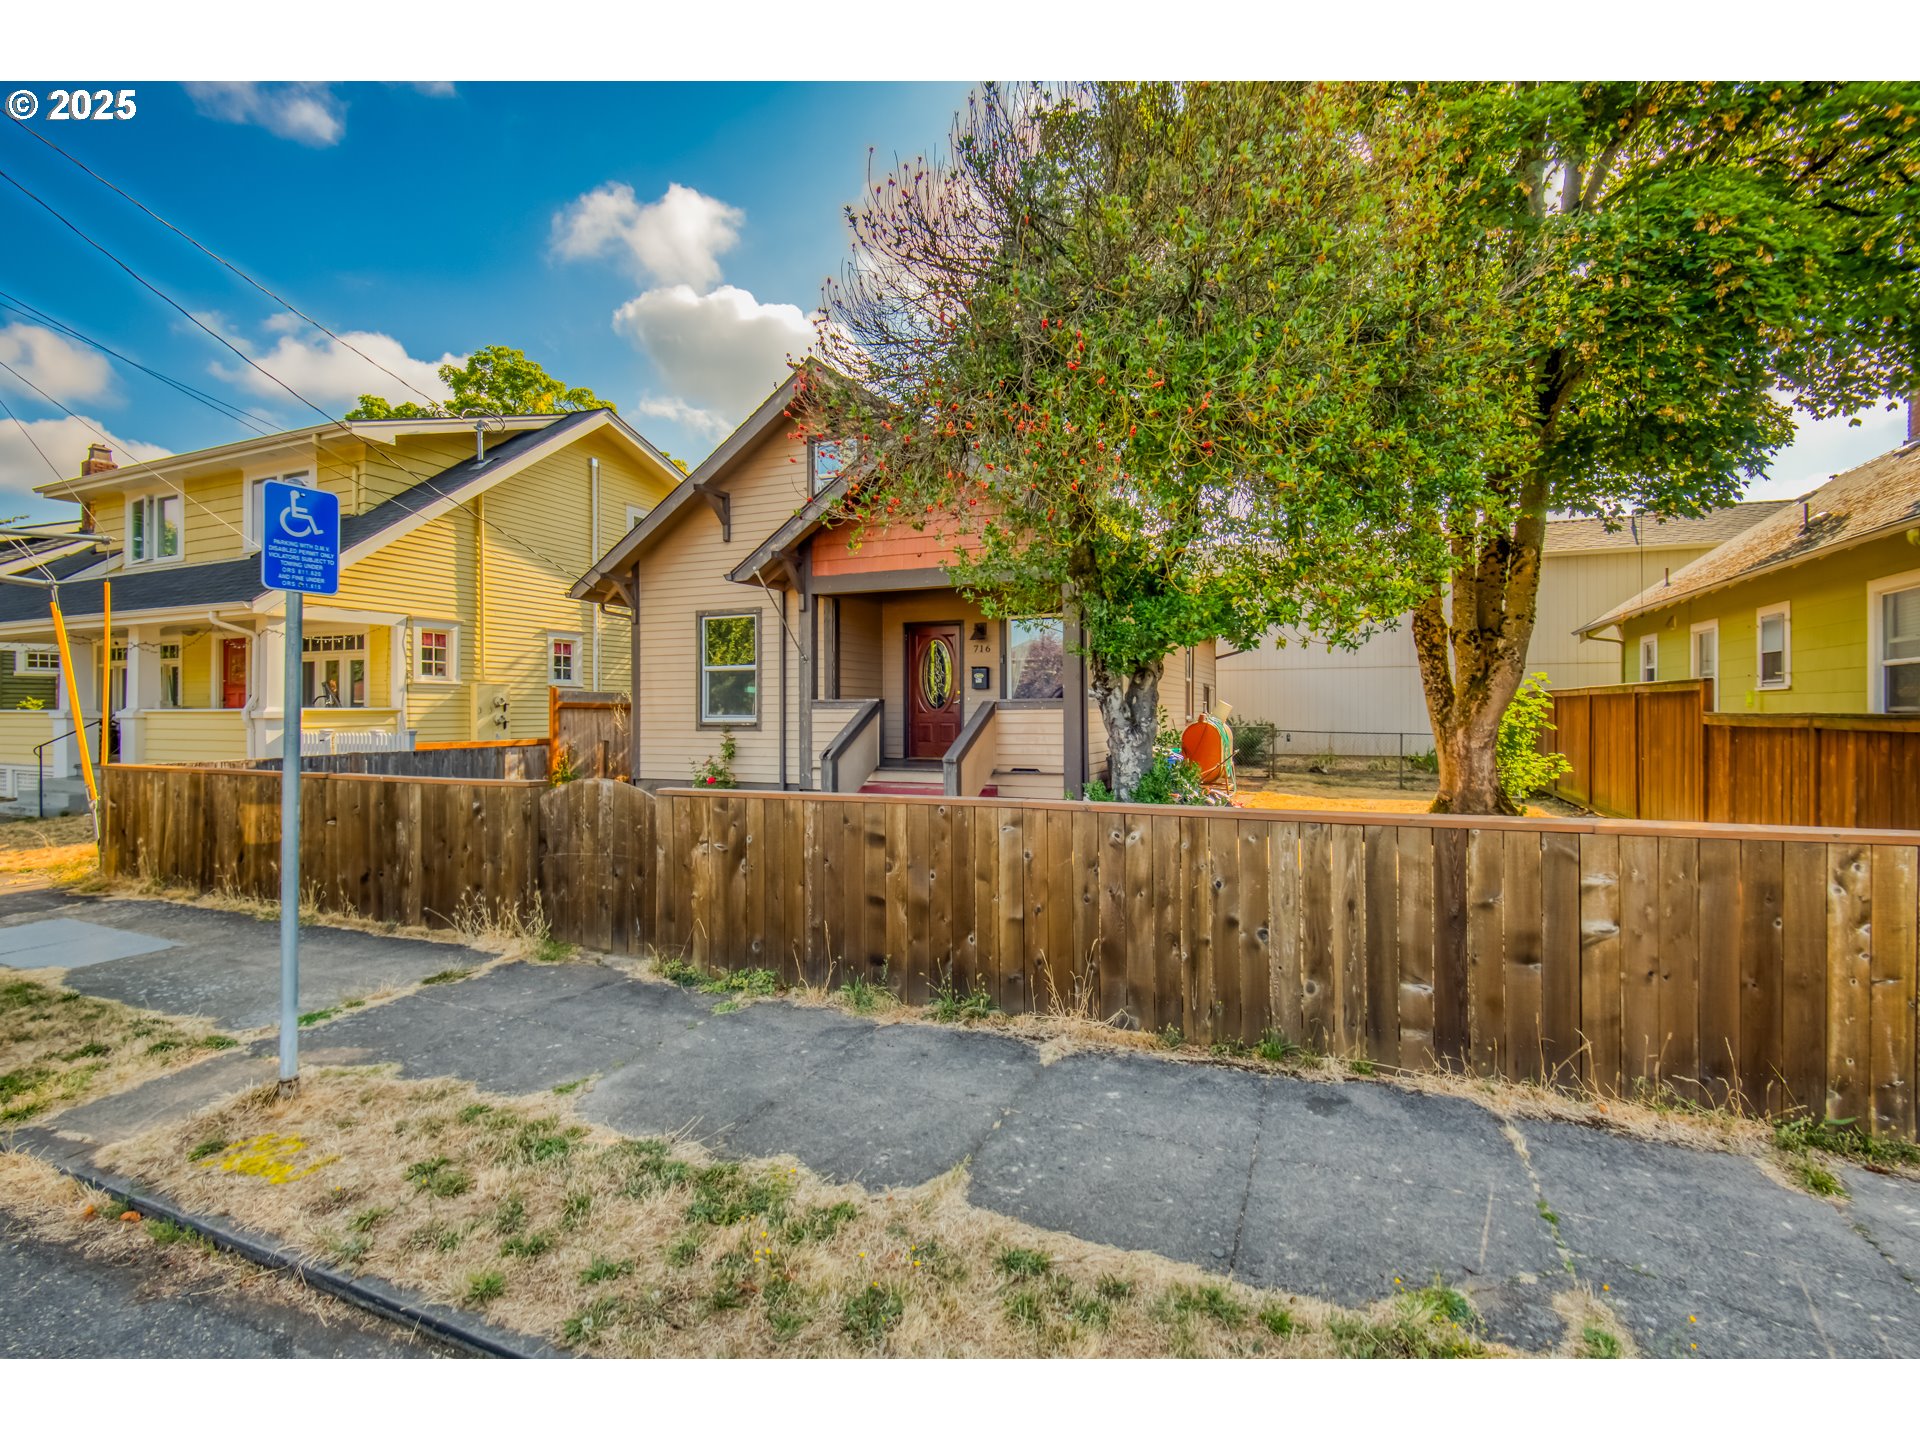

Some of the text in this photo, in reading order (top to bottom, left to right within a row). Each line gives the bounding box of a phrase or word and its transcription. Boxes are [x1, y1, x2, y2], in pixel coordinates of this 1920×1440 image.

[273, 538, 299, 547] PARKING
[268, 544, 297, 554] DISABLED
[268, 552, 300, 560] VIOLATORS
[301, 556, 327, 564] SUBJECT
[280, 560, 323, 571] TOWING UNDER
[973, 644, 991, 653] 716
